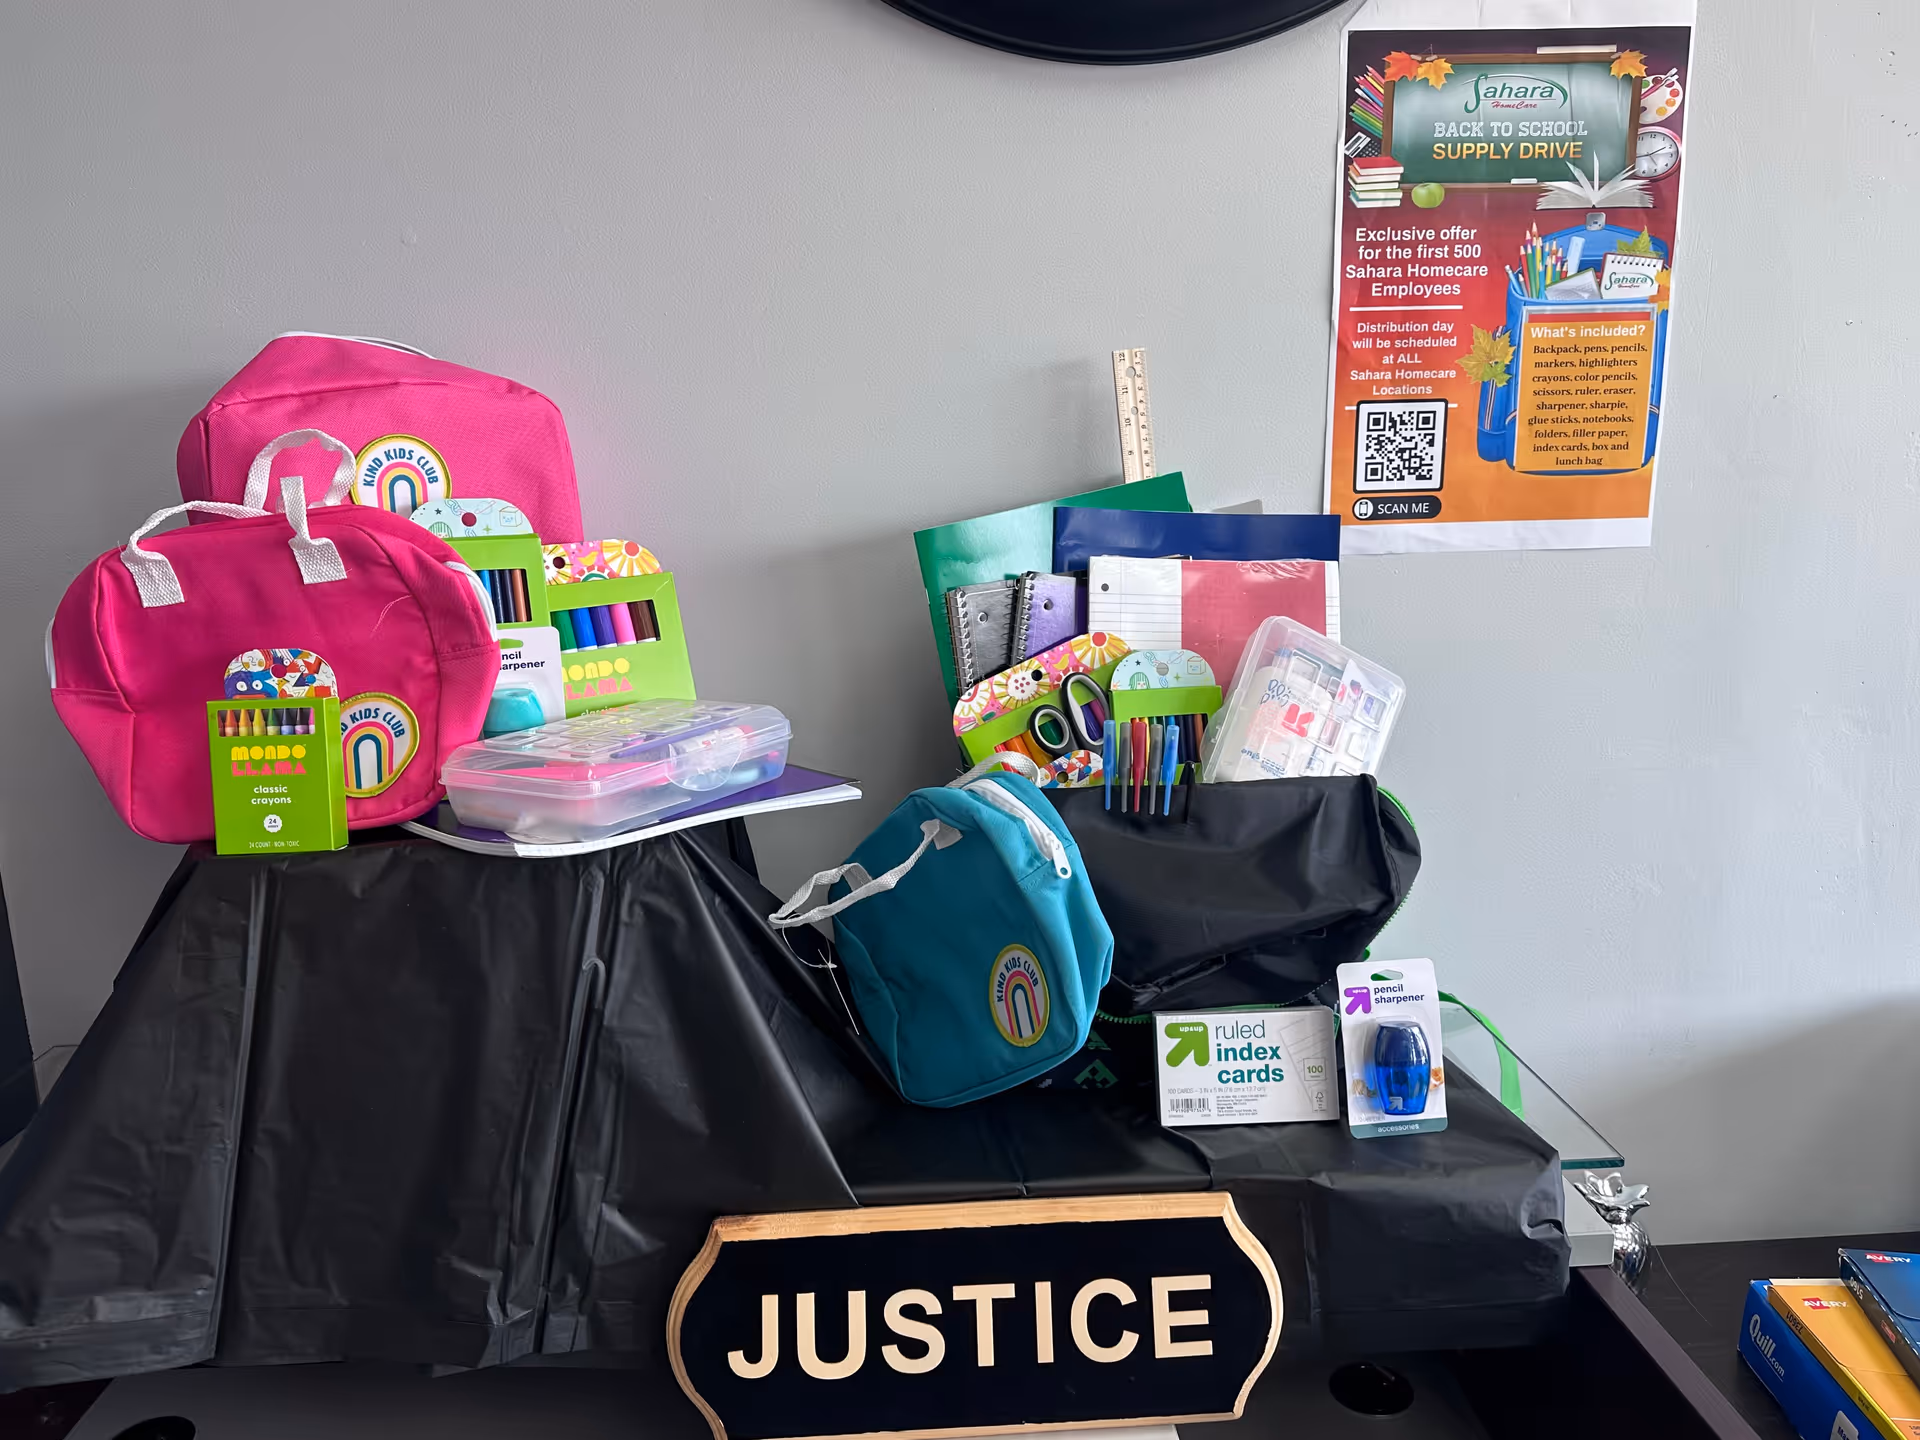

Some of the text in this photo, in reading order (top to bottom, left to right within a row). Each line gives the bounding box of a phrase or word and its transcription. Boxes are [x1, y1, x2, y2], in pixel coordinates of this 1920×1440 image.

[1464, 73, 1554, 113] Sahara
[1491, 101, 1537, 109] HomeCare
[1434, 121, 1588, 138] BACK TO SCHOOL
[1432, 142, 1583, 160] SUPPLY DRIVE
[1356, 226, 1477, 241] Exclusive offer
[1358, 244, 1481, 260] for the first 500
[1346, 264, 1488, 278] Sahara Homecare
[1371, 282, 1461, 298] Employees
[1357, 321, 1454, 333] Distribution day
[1531, 325, 1646, 338] What's included?
[1352, 336, 1457, 348] will be scheduled
[1534, 343, 1647, 355] Backpack, pens, pencils,
[1382, 353, 1422, 364] at ALL
[1534, 358, 1637, 368] markers, highlighters
[1350, 369, 1456, 380] Sahara Homecare
[1532, 372, 1637, 384] crayons, color pencils,
[1373, 384, 1432, 395] Locations
[1533, 388, 1573, 396] scissors,
[1575, 387, 1601, 395] ruler,
[1536, 400, 1628, 412] sharpener, sharpie,
[1528, 414, 1634, 426] glue sticks, notebooks,
[1534, 429, 1628, 440] folders, filler paper,
[1533, 442, 1629, 452] index cards, box and
[363, 448, 438, 486] KIND KIDS CLUB
[1556, 457, 1603, 466] lunch bag
[1378, 503, 1429, 514] SCAN ME
[500, 651, 521, 660] ncil
[500, 661, 545, 671] arpener
[565, 676, 633, 700] LAMA
[349, 708, 405, 738] KIDS CLUB
[231, 745, 306, 760] MONDO
[232, 761, 306, 776] LLAMA
[254, 785, 288, 793] classic
[251, 797, 291, 806] crayons
[997, 957, 1038, 1002] KIND KIDS CLUB
[1374, 984, 1403, 995] pencil
[1375, 994, 1424, 1004] sharpener
[1215, 1020, 1265, 1040] ruled
[1216, 1042, 1281, 1061] index
[1217, 1064, 1284, 1084] cards
[1307, 1065, 1323, 1073] 100
[1378, 1124, 1419, 1132] accessories
[727, 1274, 1214, 1379] JUSTICE
